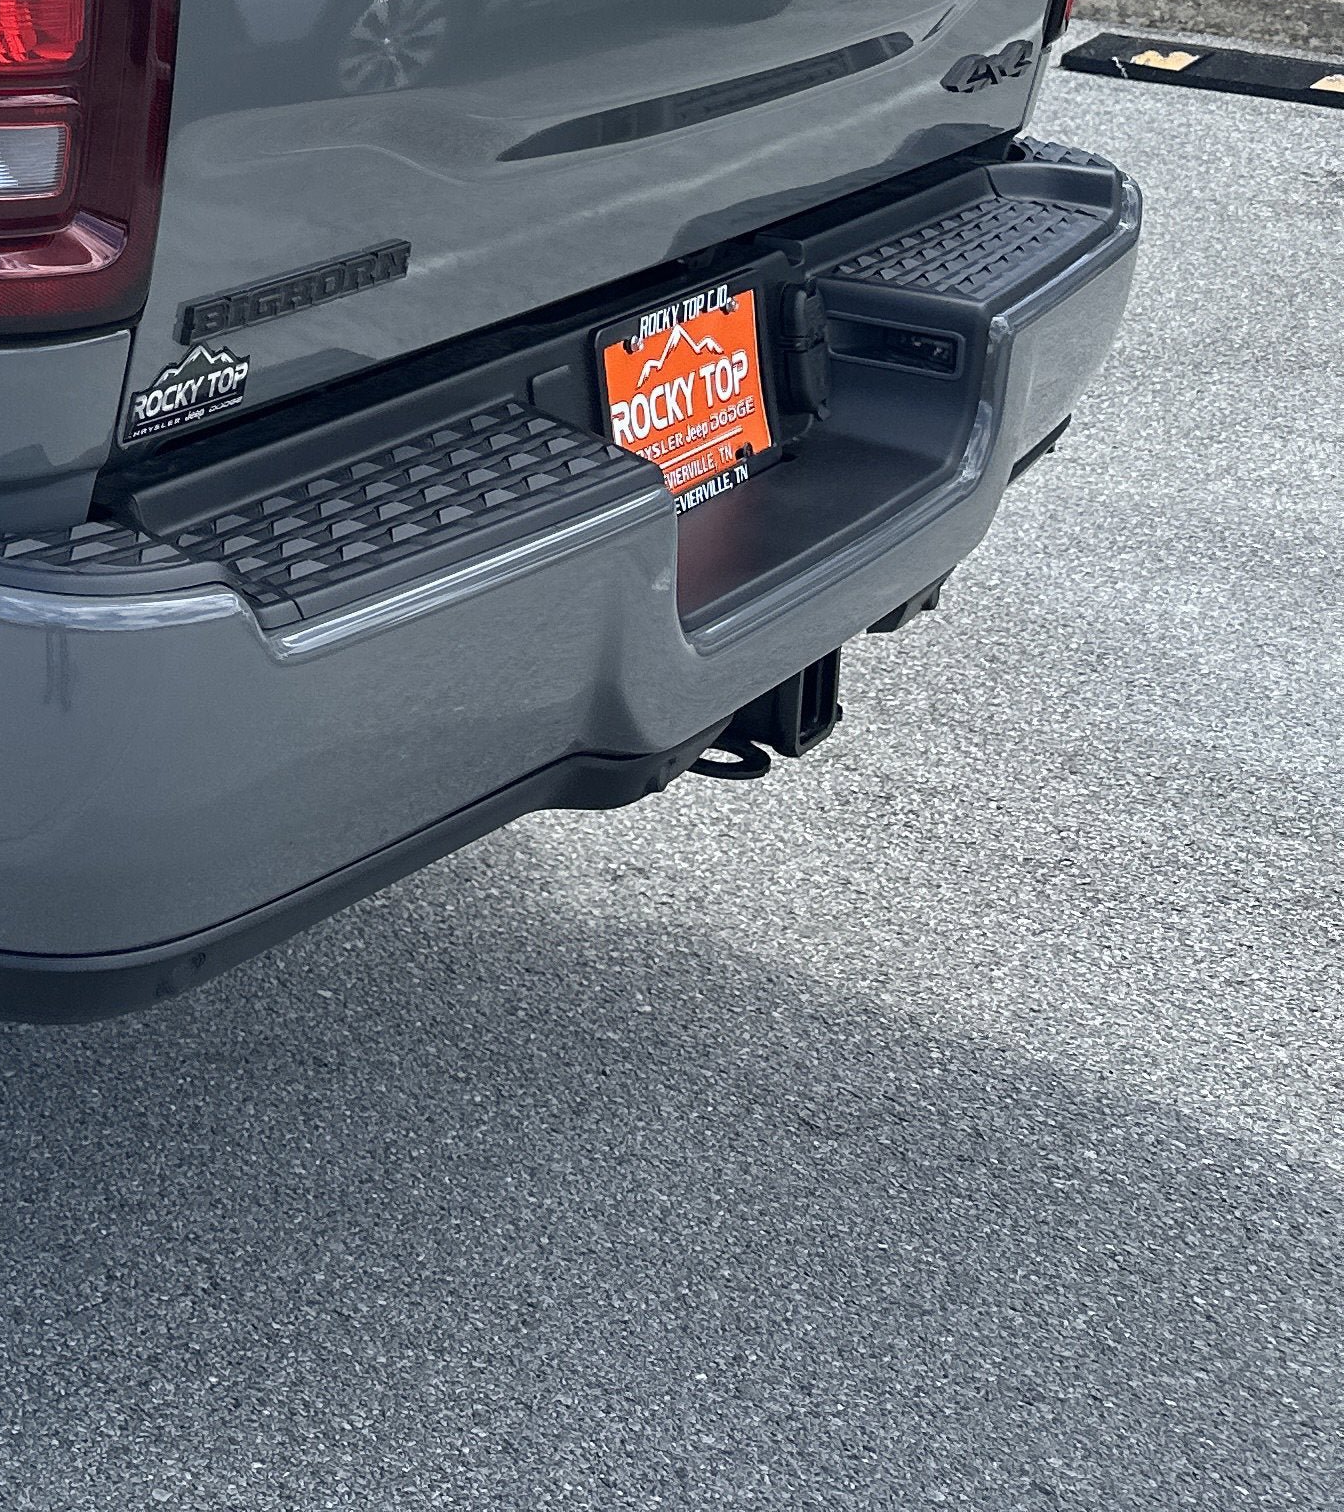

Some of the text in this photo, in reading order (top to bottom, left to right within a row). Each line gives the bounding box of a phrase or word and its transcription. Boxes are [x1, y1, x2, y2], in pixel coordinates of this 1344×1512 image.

[640, 304, 679, 339] ROCKY
[683, 294, 704, 322] TOP
[134, 362, 249, 419] ROCKY TOP
[610, 349, 748, 445] ROCKY TOP
[685, 421, 709, 443] Jeep
[709, 396, 755, 430] DODGE
[664, 442, 732, 490] VIERVILLE, TN
[674, 463, 749, 515] EVIERVILLE, TN
